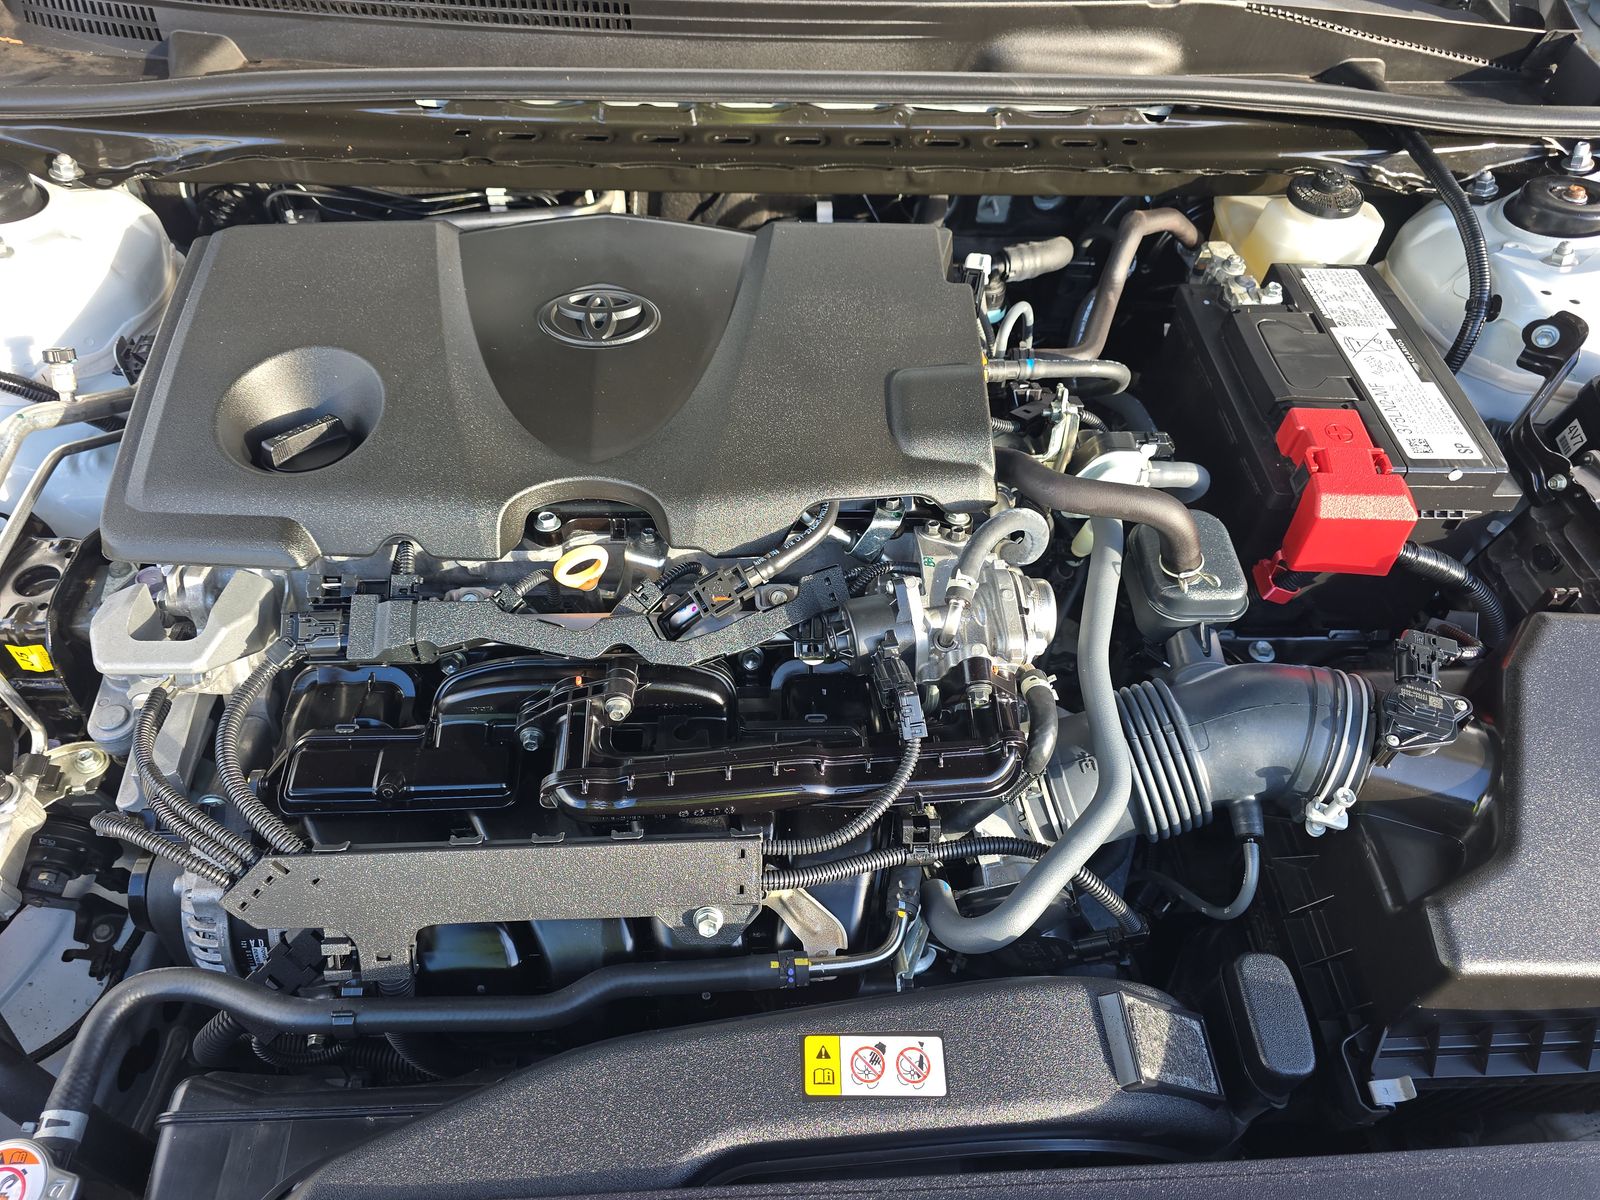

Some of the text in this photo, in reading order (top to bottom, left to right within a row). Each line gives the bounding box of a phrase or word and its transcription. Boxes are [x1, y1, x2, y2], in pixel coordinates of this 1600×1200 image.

[1396, 339, 1415, 363] CLARIOS
[1568, 425, 1584, 446] 4V7
[1454, 443, 1474, 454] SP
